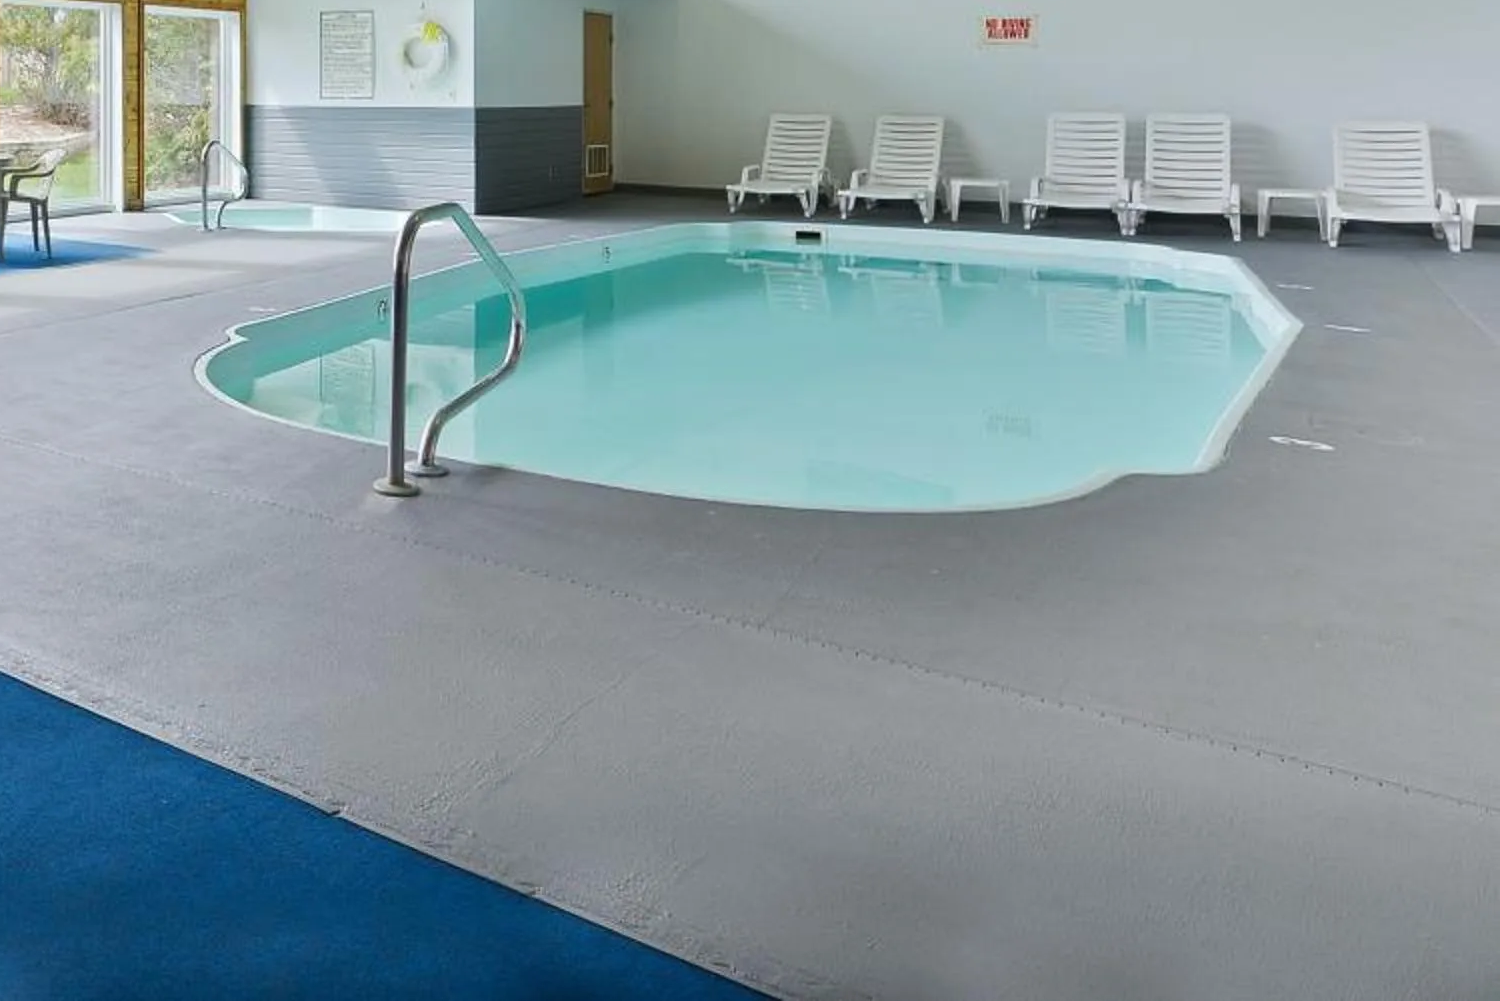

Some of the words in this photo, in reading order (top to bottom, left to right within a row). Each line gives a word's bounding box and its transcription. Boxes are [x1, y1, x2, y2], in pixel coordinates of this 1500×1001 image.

[986, 18, 998, 28] NO
[1002, 18, 1031, 28] DIVING
[988, 28, 1029, 39] ALLOWED
